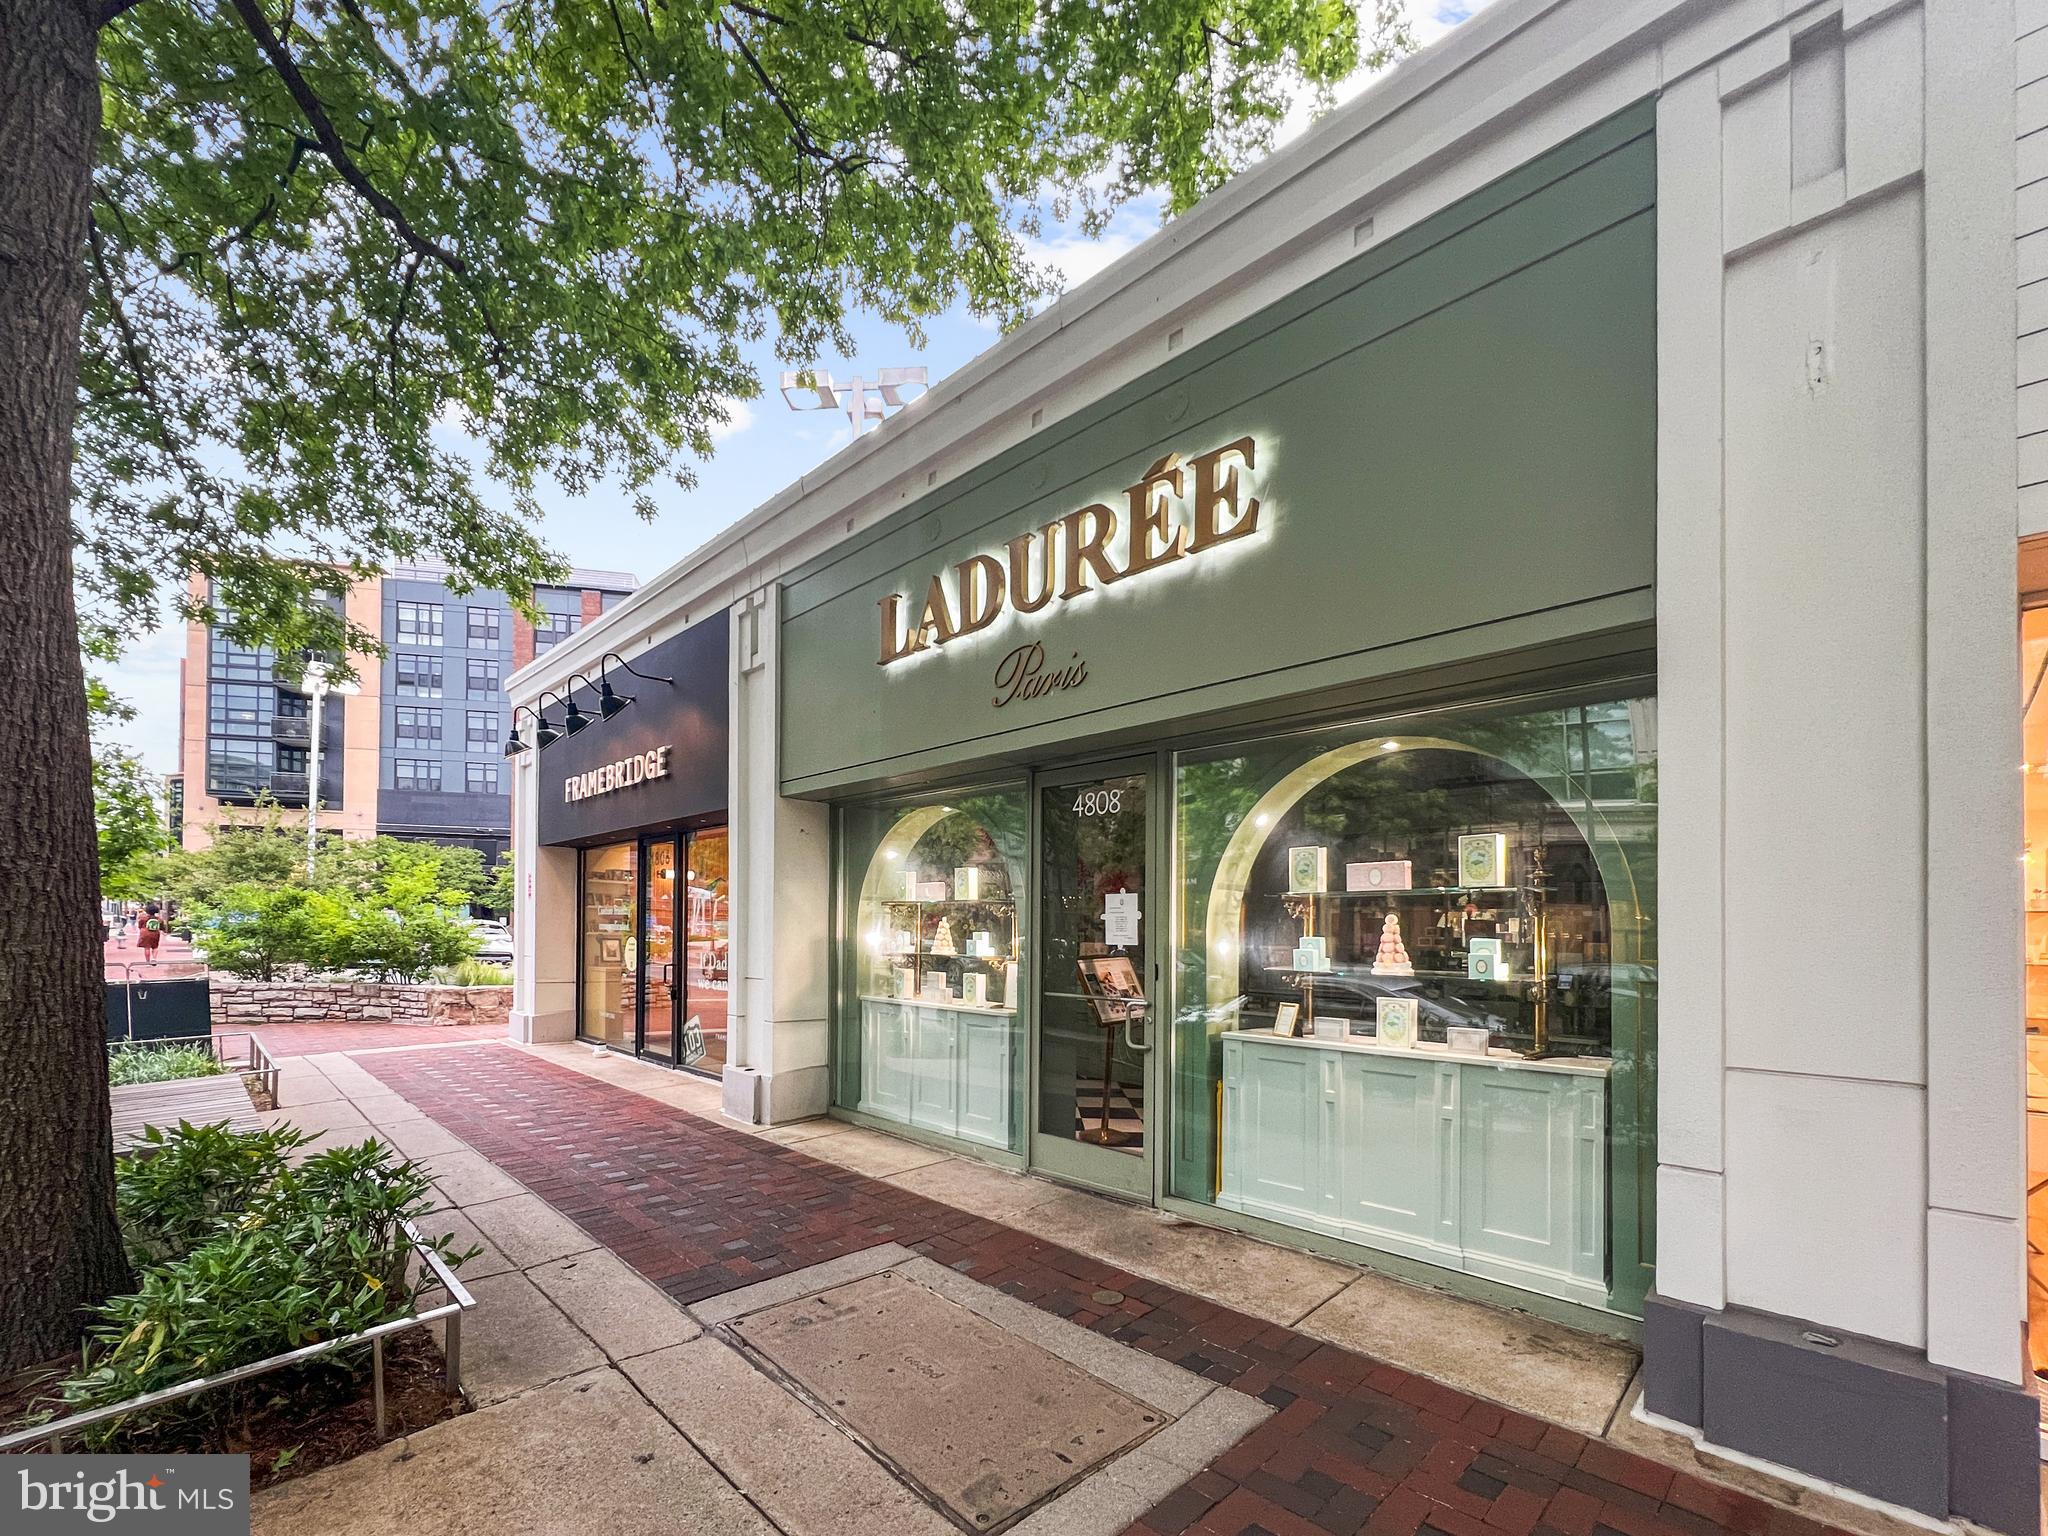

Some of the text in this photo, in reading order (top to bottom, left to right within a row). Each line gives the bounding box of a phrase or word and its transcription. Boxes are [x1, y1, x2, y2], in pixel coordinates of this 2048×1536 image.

[877, 436, 1261, 667] LADURÉE
[991, 640, 1089, 708] Paris
[564, 745, 672, 803] FRAMEBRIDGE
[1072, 789, 1121, 817] 4808
